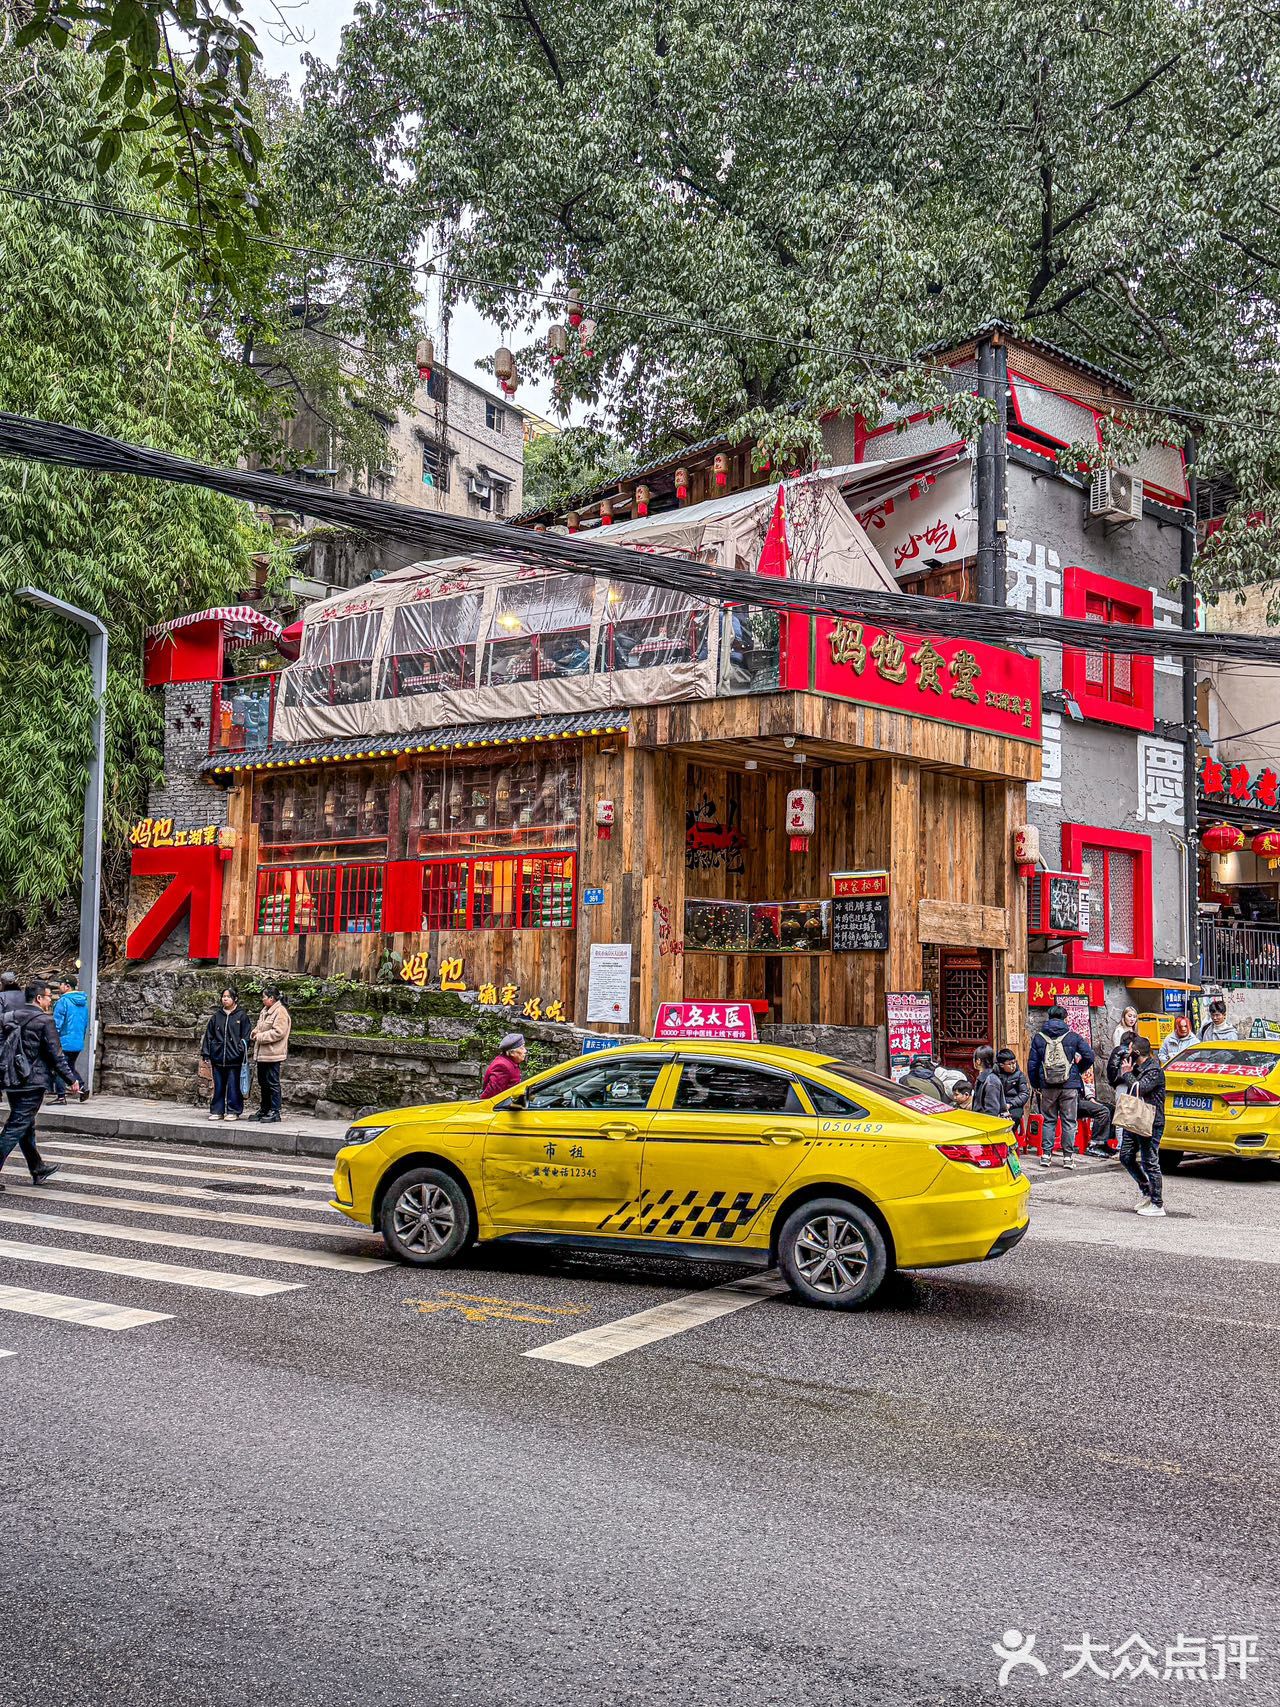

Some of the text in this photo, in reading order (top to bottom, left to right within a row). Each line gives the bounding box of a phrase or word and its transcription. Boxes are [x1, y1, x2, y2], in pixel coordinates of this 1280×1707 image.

[829, 617, 982, 704] 妈也食堂
[129, 818, 174, 848] 妈也
[174, 825, 218, 847] 江湖菜
[400, 952, 565, 1022] 妈也 确实 好吃
[684, 1005, 744, 1028] 名太医
[822, 1121, 883, 1133] 050489
